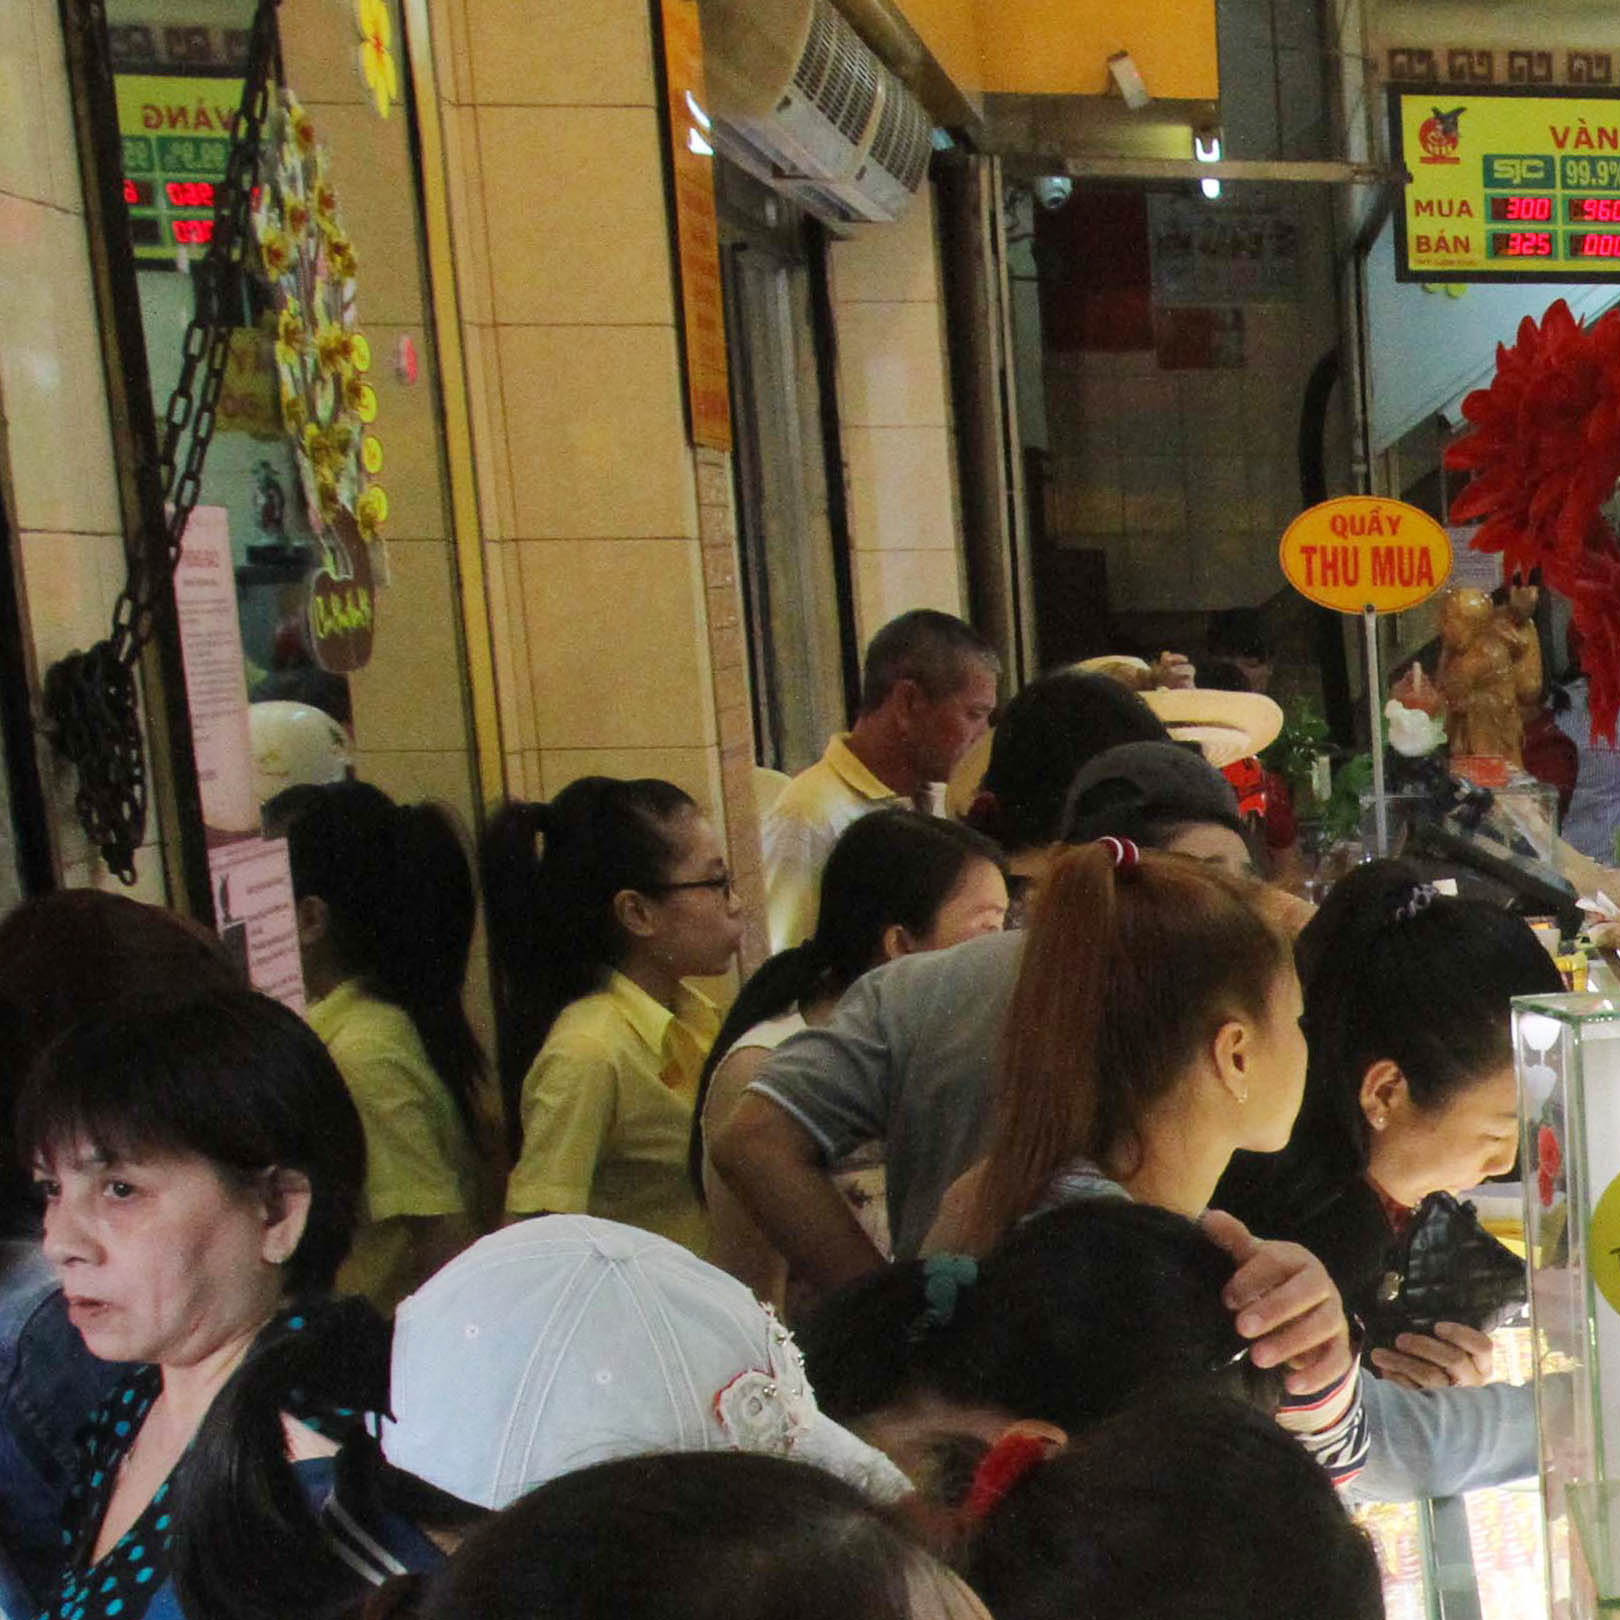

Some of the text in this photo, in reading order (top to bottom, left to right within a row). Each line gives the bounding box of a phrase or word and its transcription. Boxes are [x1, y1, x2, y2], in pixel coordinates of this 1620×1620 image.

[1493, 158, 1545, 184] SJC
[1414, 199, 1473, 218] MUA
[1506, 197, 1552, 220] 300
[1416, 229, 1471, 254] BÁN
[1506, 232, 1552, 256] 325
[1329, 505, 1403, 539] QUẦY
[1300, 545, 1435, 587] THU MUA
